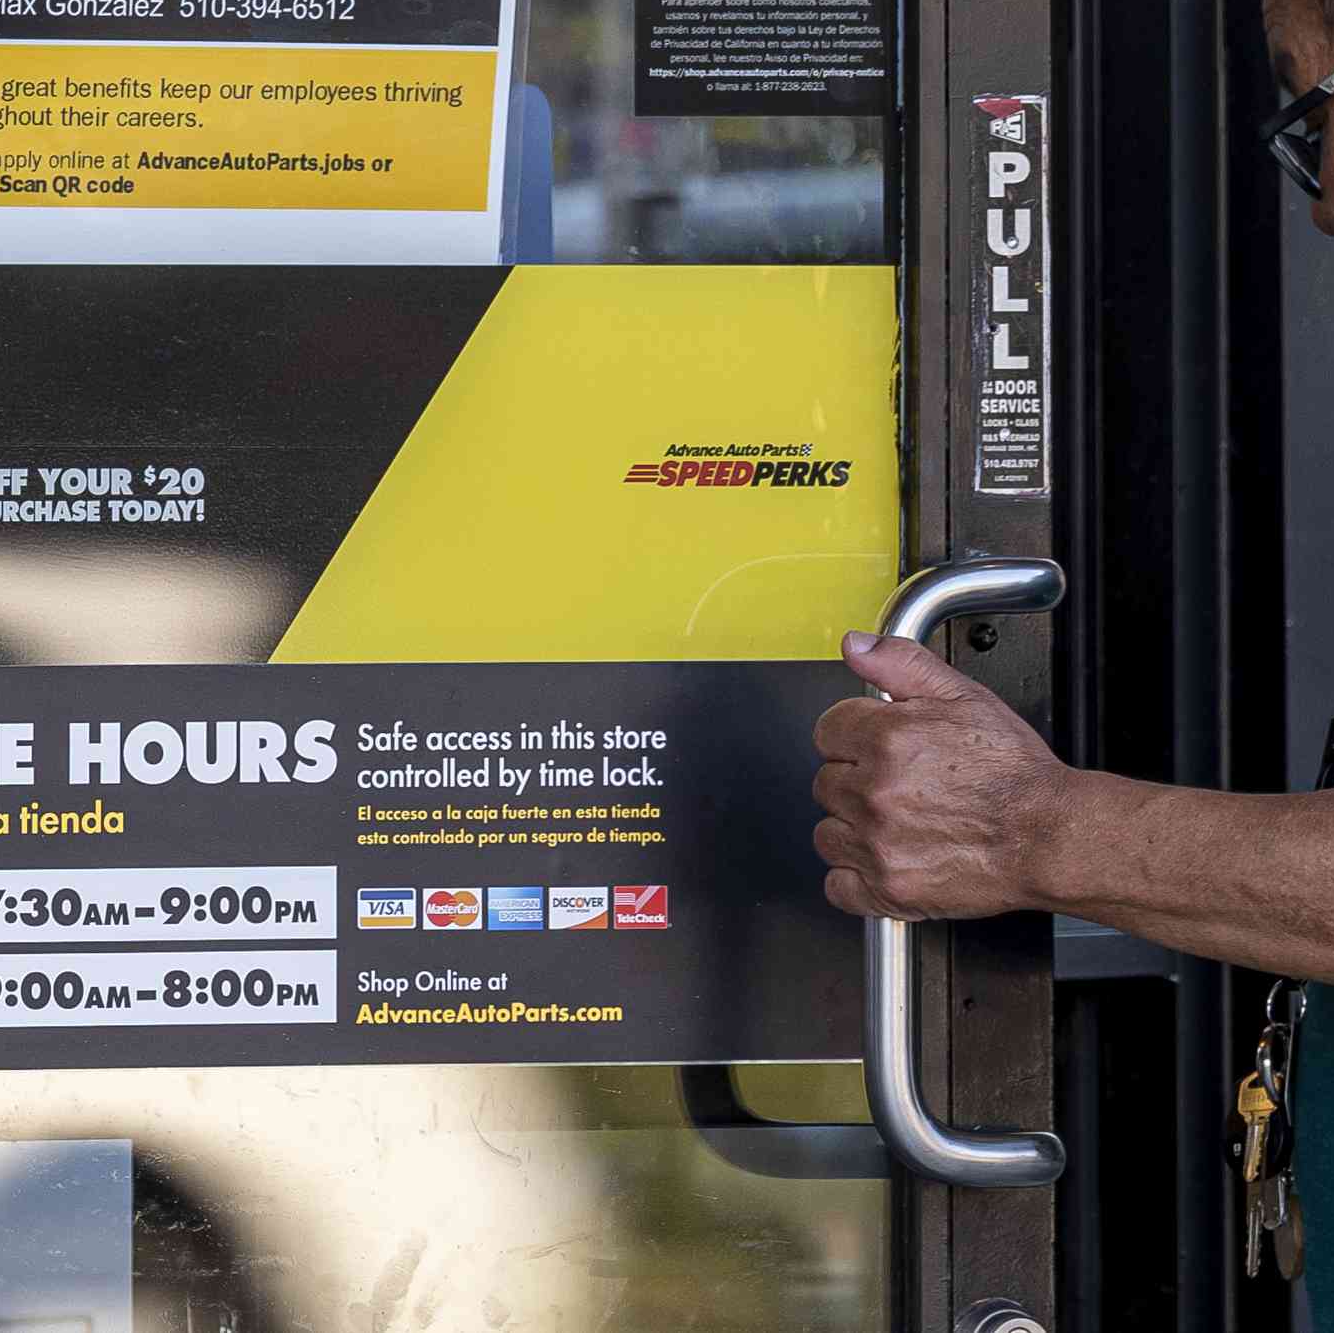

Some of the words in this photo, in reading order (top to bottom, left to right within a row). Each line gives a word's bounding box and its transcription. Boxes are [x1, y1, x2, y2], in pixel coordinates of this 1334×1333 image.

[0, 77, 57, 103] great
[64, 76, 152, 99] benefits
[159, 77, 212, 103] keep
[219, 82, 253, 100] our
[260, 79, 377, 105] employees
[384, 80, 464, 107] thriving
[59, 105, 109, 128] their
[115, 109, 205, 128] careers.
[48, 151, 105, 170] online
[111, 152, 131, 170] at
[136, 152, 365, 176] AdvanceAutoParts.jobs
[370, 157, 393, 172] or
[51, 176, 82, 196] QR
[86, 177, 135, 195] code
[986, 150, 1032, 370] PULL
[995, 380, 1037, 395] DOOR
[980, 398, 1041, 414] SERVICE
[664, 444, 723, 457] Advance
[724, 444, 759, 457] Auto
[761, 444, 800, 457] Parts
[38, 468, 133, 495] YOUR
[143, 465, 205, 495] $20
[657, 461, 851, 487] SPEEDPERKS
[108, 499, 205, 522] TODAY!
[357, 720, 418, 752] Safe
[425, 728, 513, 752] access
[519, 722, 544, 750] in
[551, 719, 596, 750] this
[602, 725, 667, 750] store
[68, 720, 338, 785] HOURS
[356, 757, 490, 790] controlled
[498, 757, 532, 796] by
[539, 759, 595, 788] time
[602, 756, 664, 787] lock.
[19, 799, 125, 835] tienda
[367, 901, 405, 916] VISA
[426, 903, 479, 915] MasterCard
[552, 897, 604, 909] DISCOVER
[617, 913, 666, 924] TeleCheck
[357, 970, 408, 997] Shop
[415, 969, 482, 992] Online
[487, 972, 508, 991] at
[356, 1002, 623, 1025] AdvanceAutoParts.com
